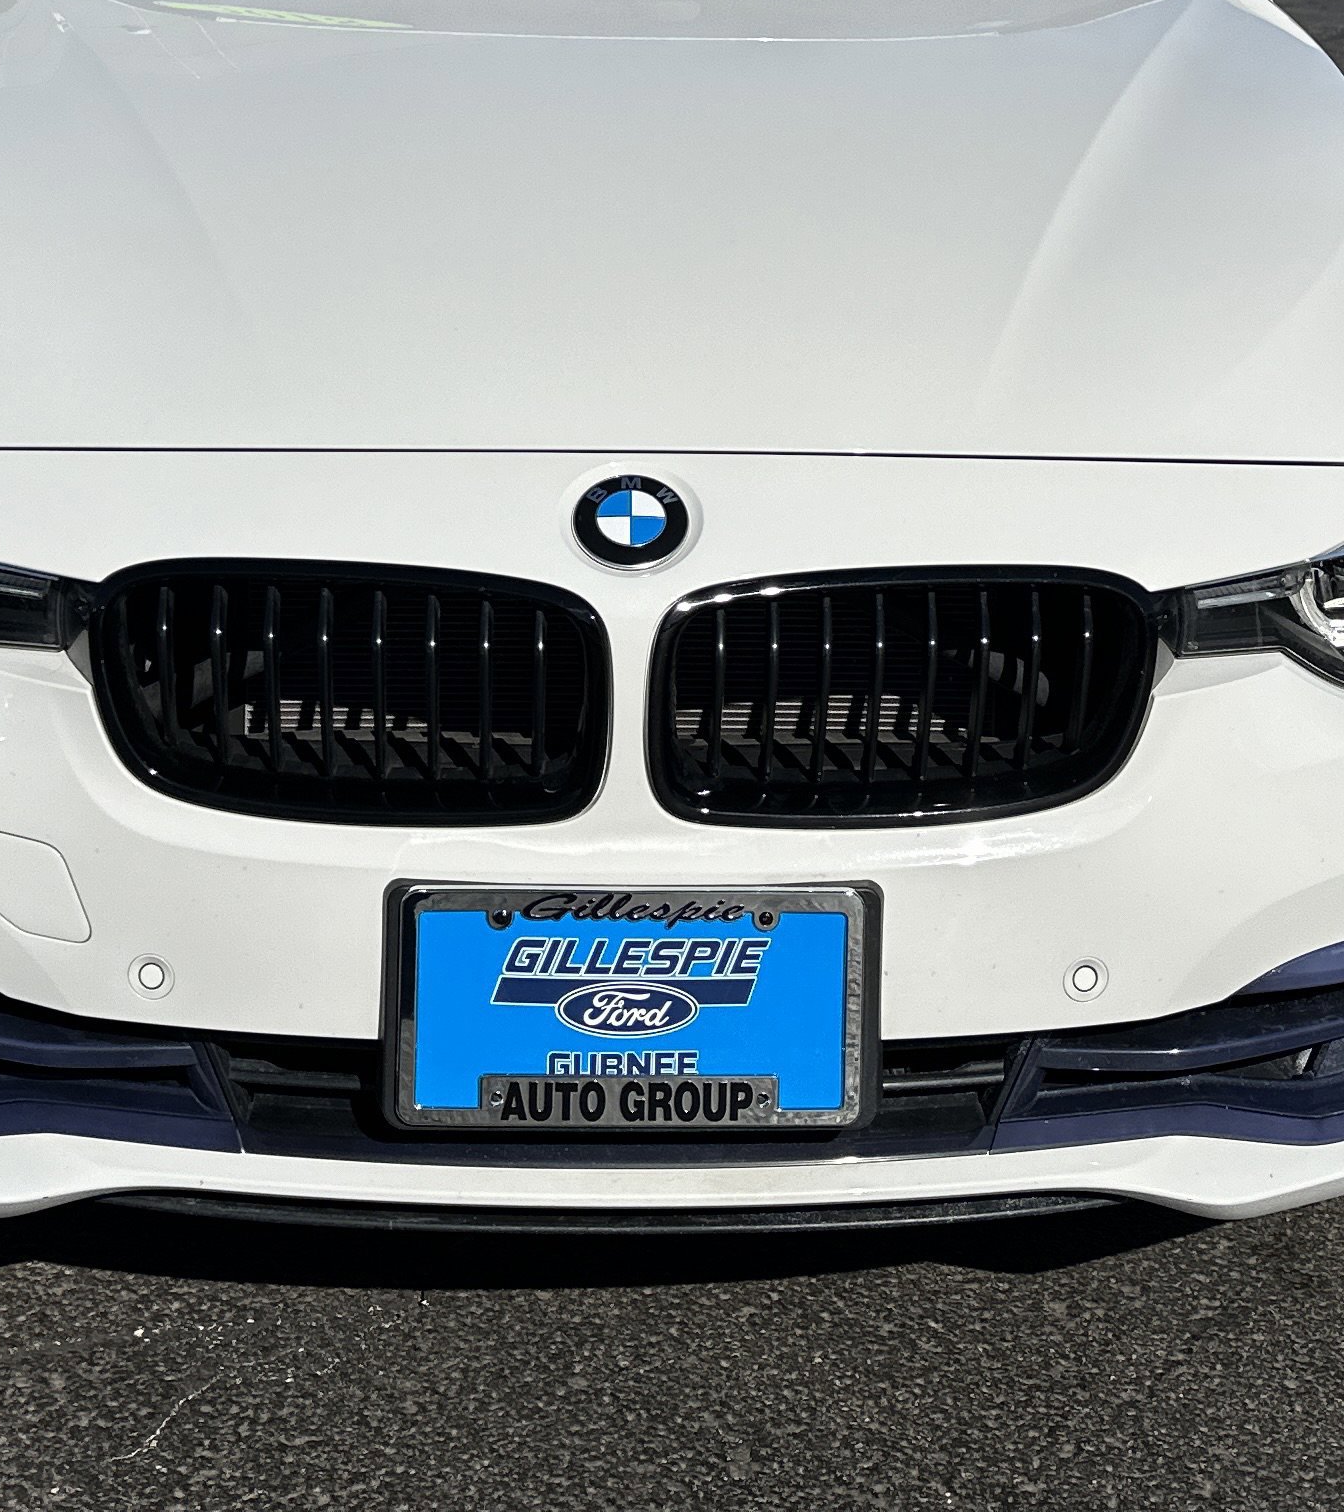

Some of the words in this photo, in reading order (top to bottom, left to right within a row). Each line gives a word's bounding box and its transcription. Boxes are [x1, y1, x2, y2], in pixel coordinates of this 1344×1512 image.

[585, 476, 680, 505] BMW
[522, 892, 746, 931] Gillespie
[502, 937, 771, 977] GILLESPIE
[582, 990, 673, 1027] Ford
[500, 1080, 606, 1122] AUTO
[619, 1080, 754, 1123] GROUP
